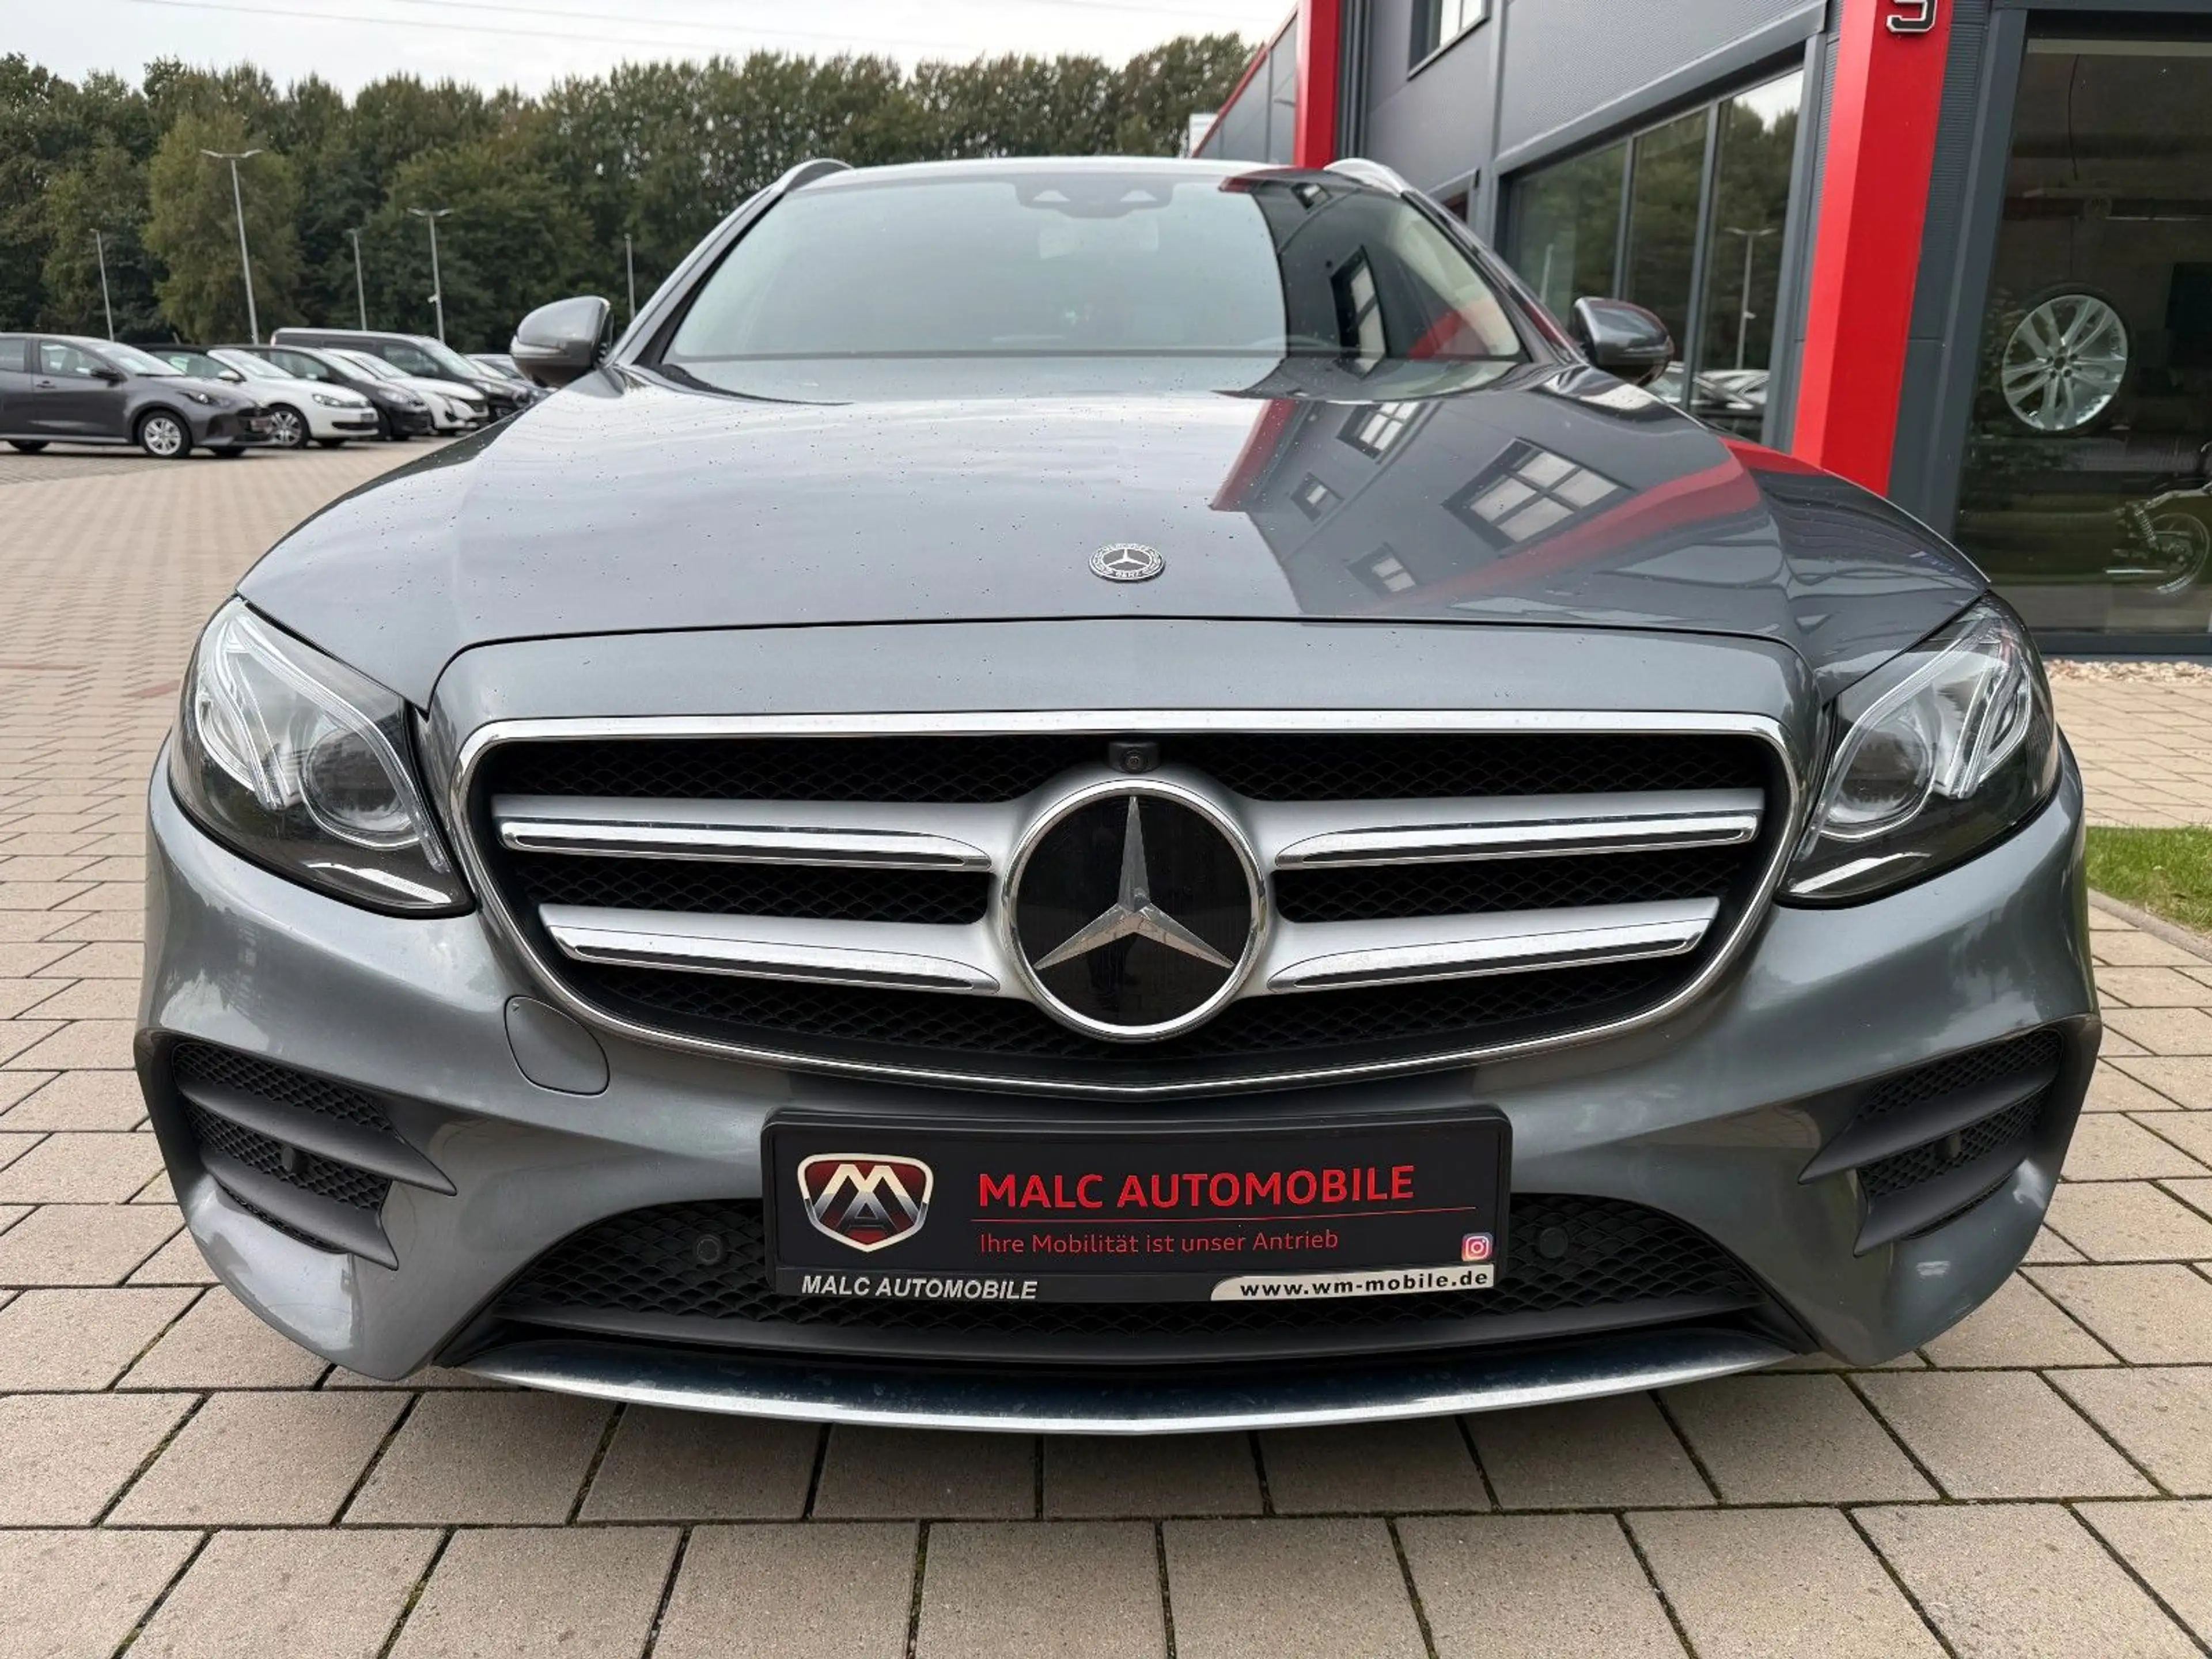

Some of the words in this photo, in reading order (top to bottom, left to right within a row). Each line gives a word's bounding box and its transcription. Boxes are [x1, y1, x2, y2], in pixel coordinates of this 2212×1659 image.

[979, 1173, 1104, 1208] MALC
[1116, 1165, 1415, 1208] AUTOMOBILE
[980, 1233, 1024, 1253] Ihre
[1033, 1234, 1138, 1253] Mobilität
[1146, 1234, 1174, 1252] ist
[1181, 1236, 1245, 1252] unser
[1252, 1229, 1338, 1250] Antrieb
[801, 1275, 871, 1296] MALC
[875, 1277, 1037, 1300] AUTOMOBILE
[1240, 1271, 1488, 1296] www.wm-mobile.de
